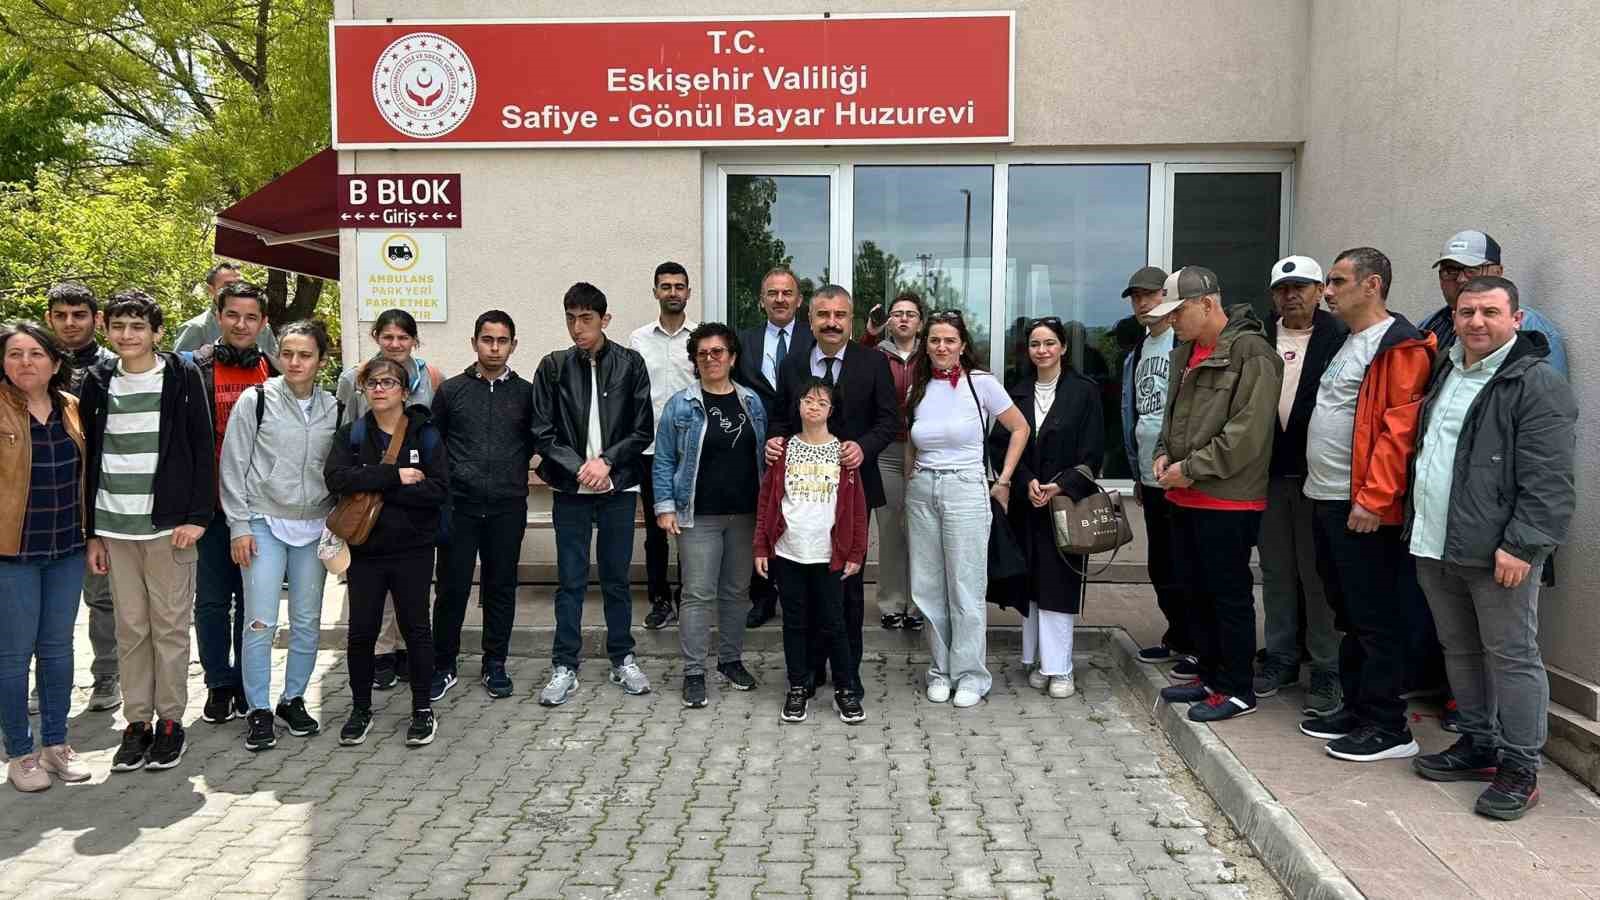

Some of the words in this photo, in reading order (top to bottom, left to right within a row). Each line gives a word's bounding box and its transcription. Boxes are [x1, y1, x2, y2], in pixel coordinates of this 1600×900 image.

[707, 30, 765, 54] T.C.
[607, 67, 753, 97] Eskişehir
[762, 65, 868, 95] Valiliği
[502, 104, 598, 134] Safiye
[629, 103, 722, 127] Gönül
[734, 103, 825, 132] Bayar
[836, 101, 974, 126] Huzurevi
[350, 179, 367, 205] B
[378, 179, 451, 205] BLOK
[383, 209, 417, 226] Giriş
[368, 274, 434, 284] AMBULANS
[372, 286, 402, 296] PARK
[407, 285, 432, 296] YERİ
[366, 298, 397, 307] PARK
[400, 298, 439, 307] ETMEK
